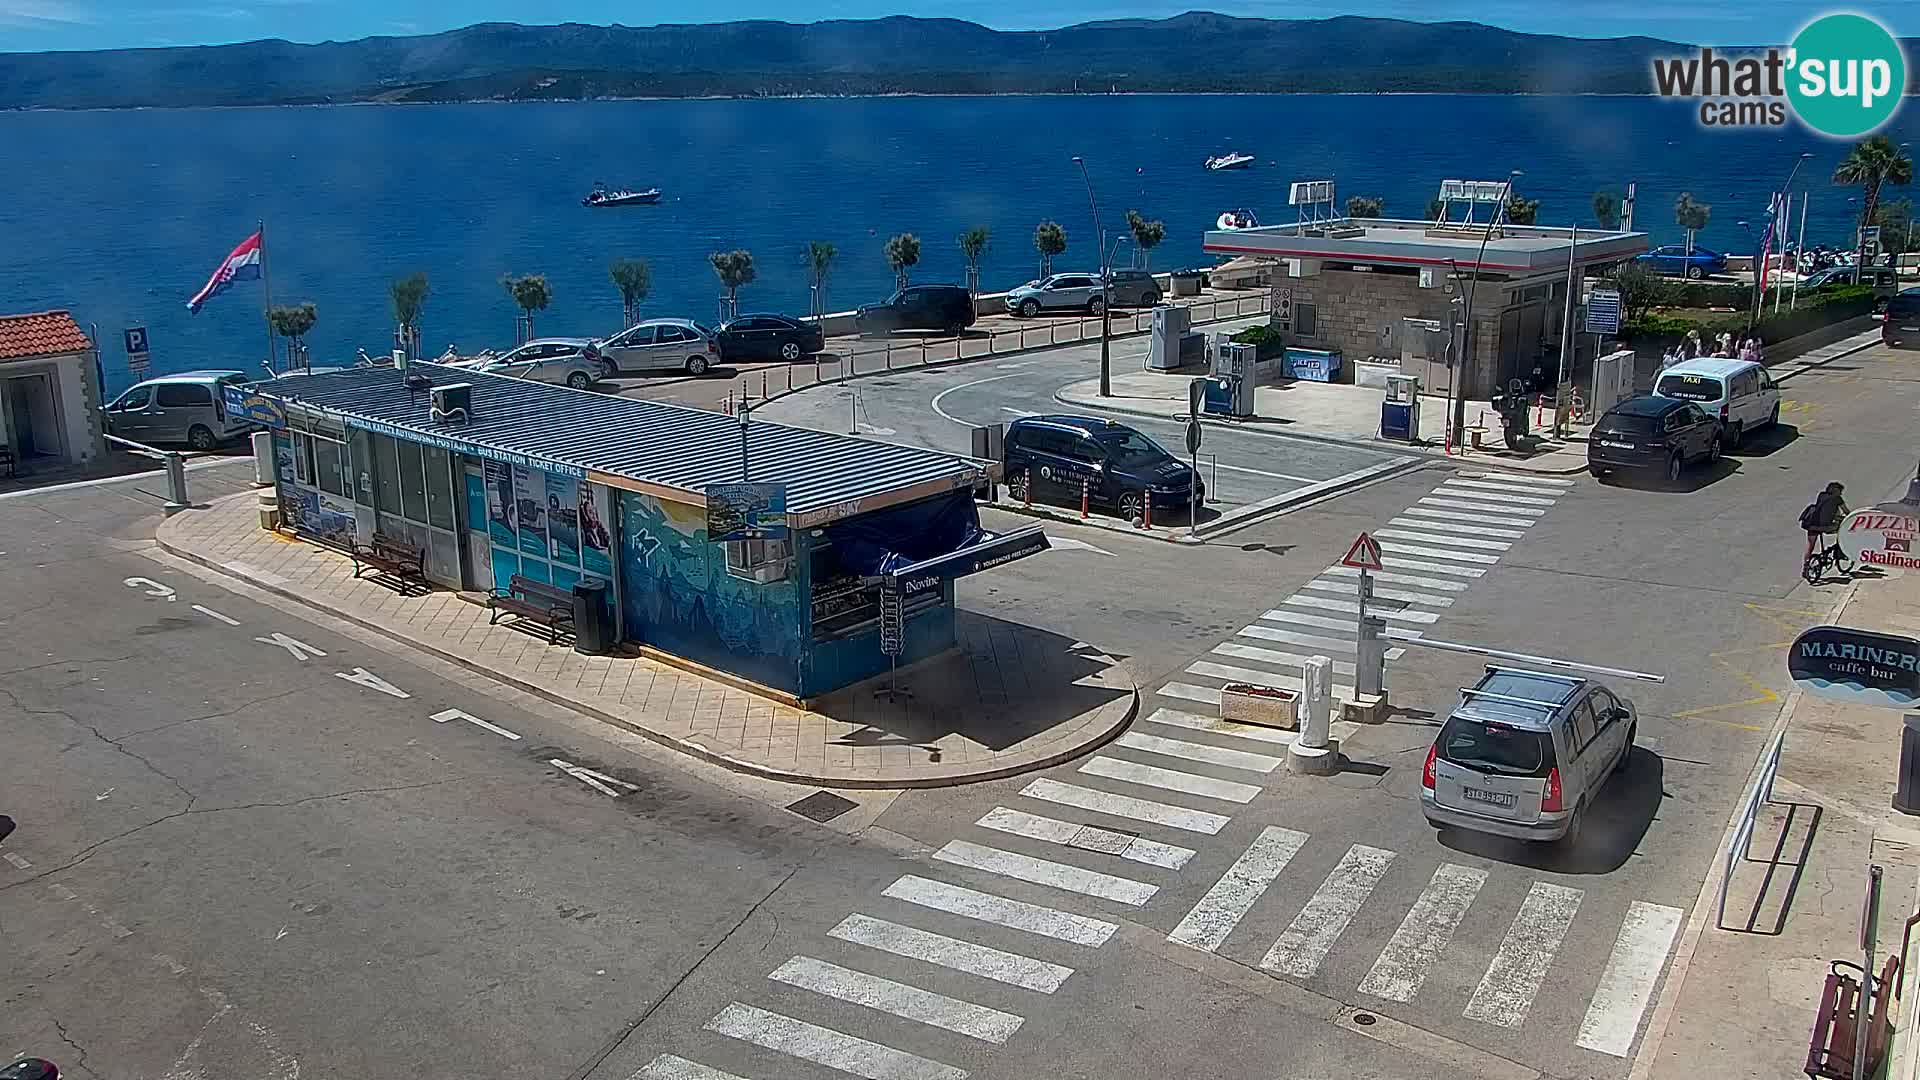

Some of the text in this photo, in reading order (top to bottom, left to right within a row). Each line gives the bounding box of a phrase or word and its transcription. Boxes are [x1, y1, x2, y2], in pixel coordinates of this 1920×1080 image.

[130, 331, 142, 350] P
[1683, 376, 1701, 384] TAXI
[436, 437, 468, 452] POSTAJA
[478, 446, 493, 459] BUS
[494, 450, 526, 465] STATION
[529, 457, 554, 472] TICKET
[555, 462, 582, 477] OFFICE
[1848, 514, 1920, 533] PIZZE
[1829, 661, 1897, 680] caffe bar
